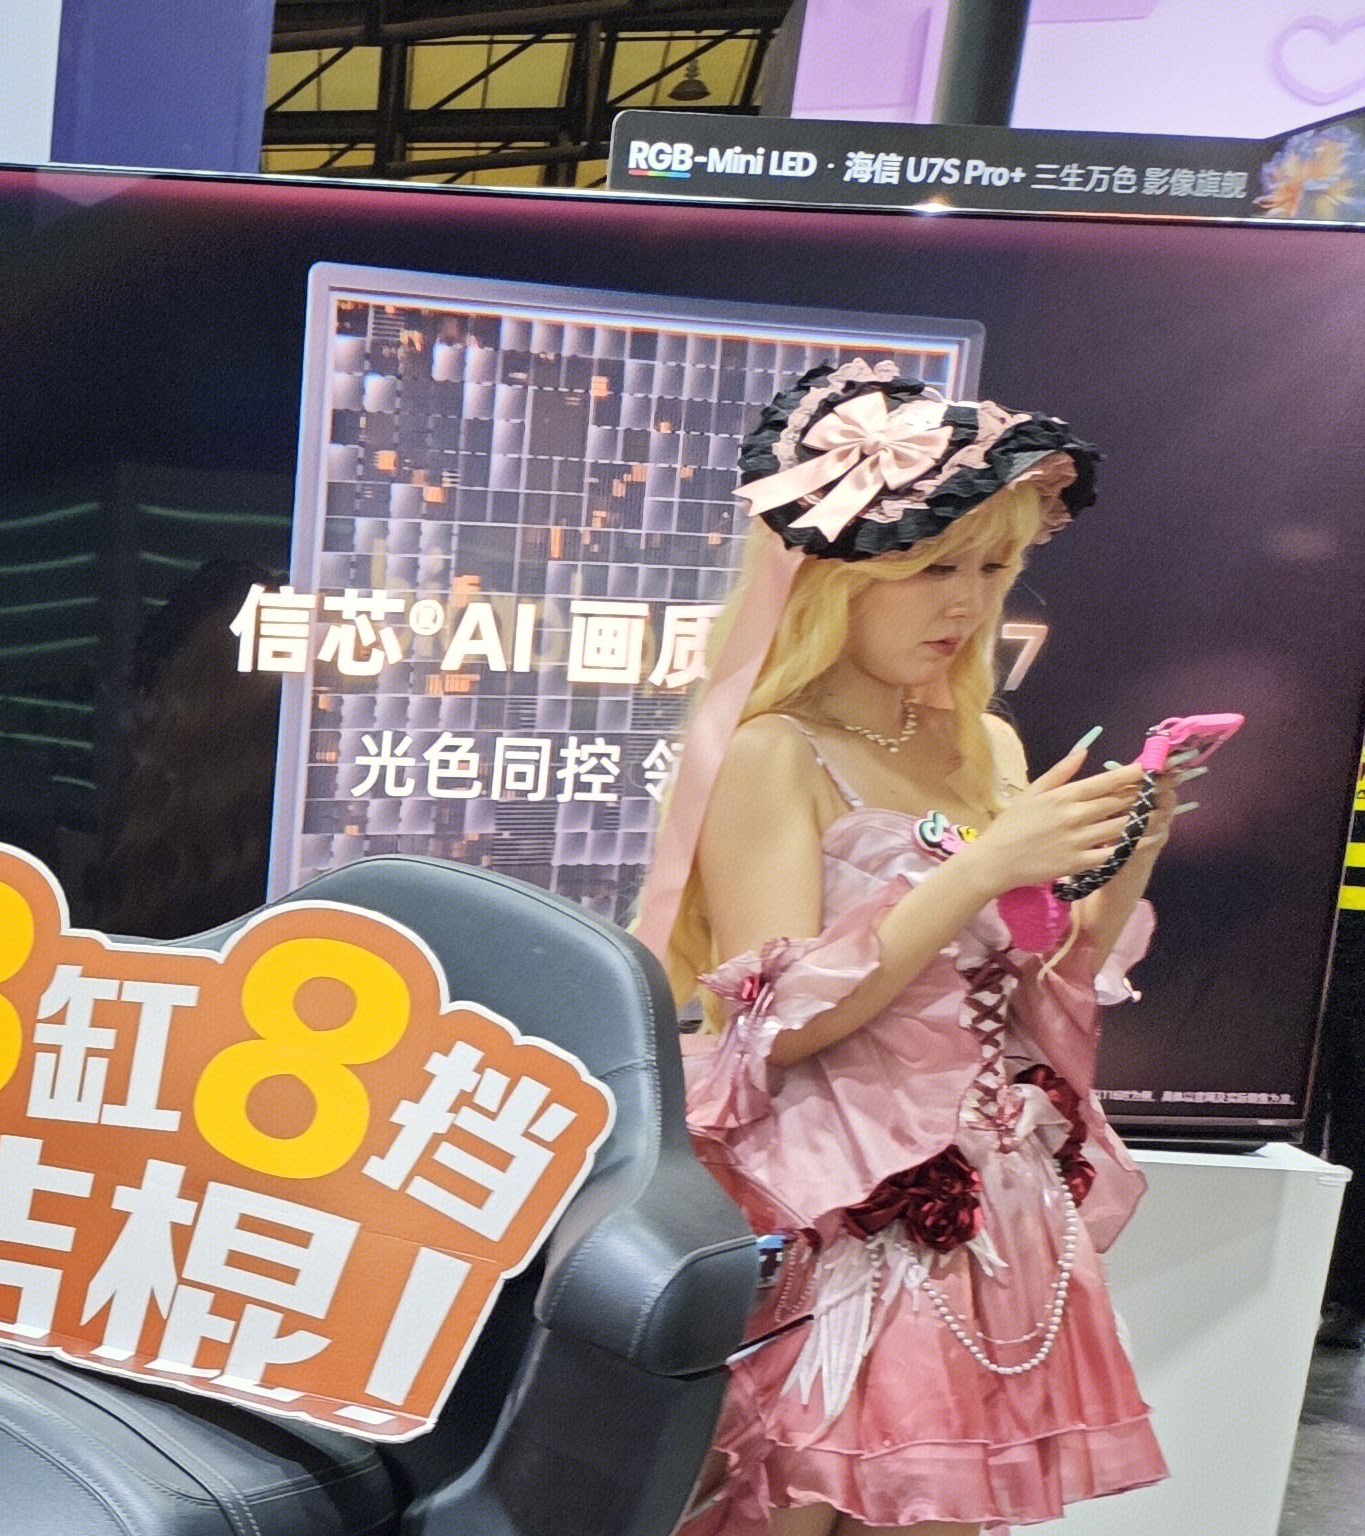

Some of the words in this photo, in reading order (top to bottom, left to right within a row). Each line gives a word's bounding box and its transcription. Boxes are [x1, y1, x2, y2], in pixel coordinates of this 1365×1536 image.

[628, 139, 764, 177] RGB-Mini
[769, 150, 818, 179] LED
[842, 150, 900, 185] 海信
[906, 156, 961, 185] U7S
[965, 159, 1026, 188] Pro+
[1030, 165, 1138, 196] 三生万色
[1142, 167, 1248, 200] 影像旗舰
[351, 730, 622, 803] 光色同控
